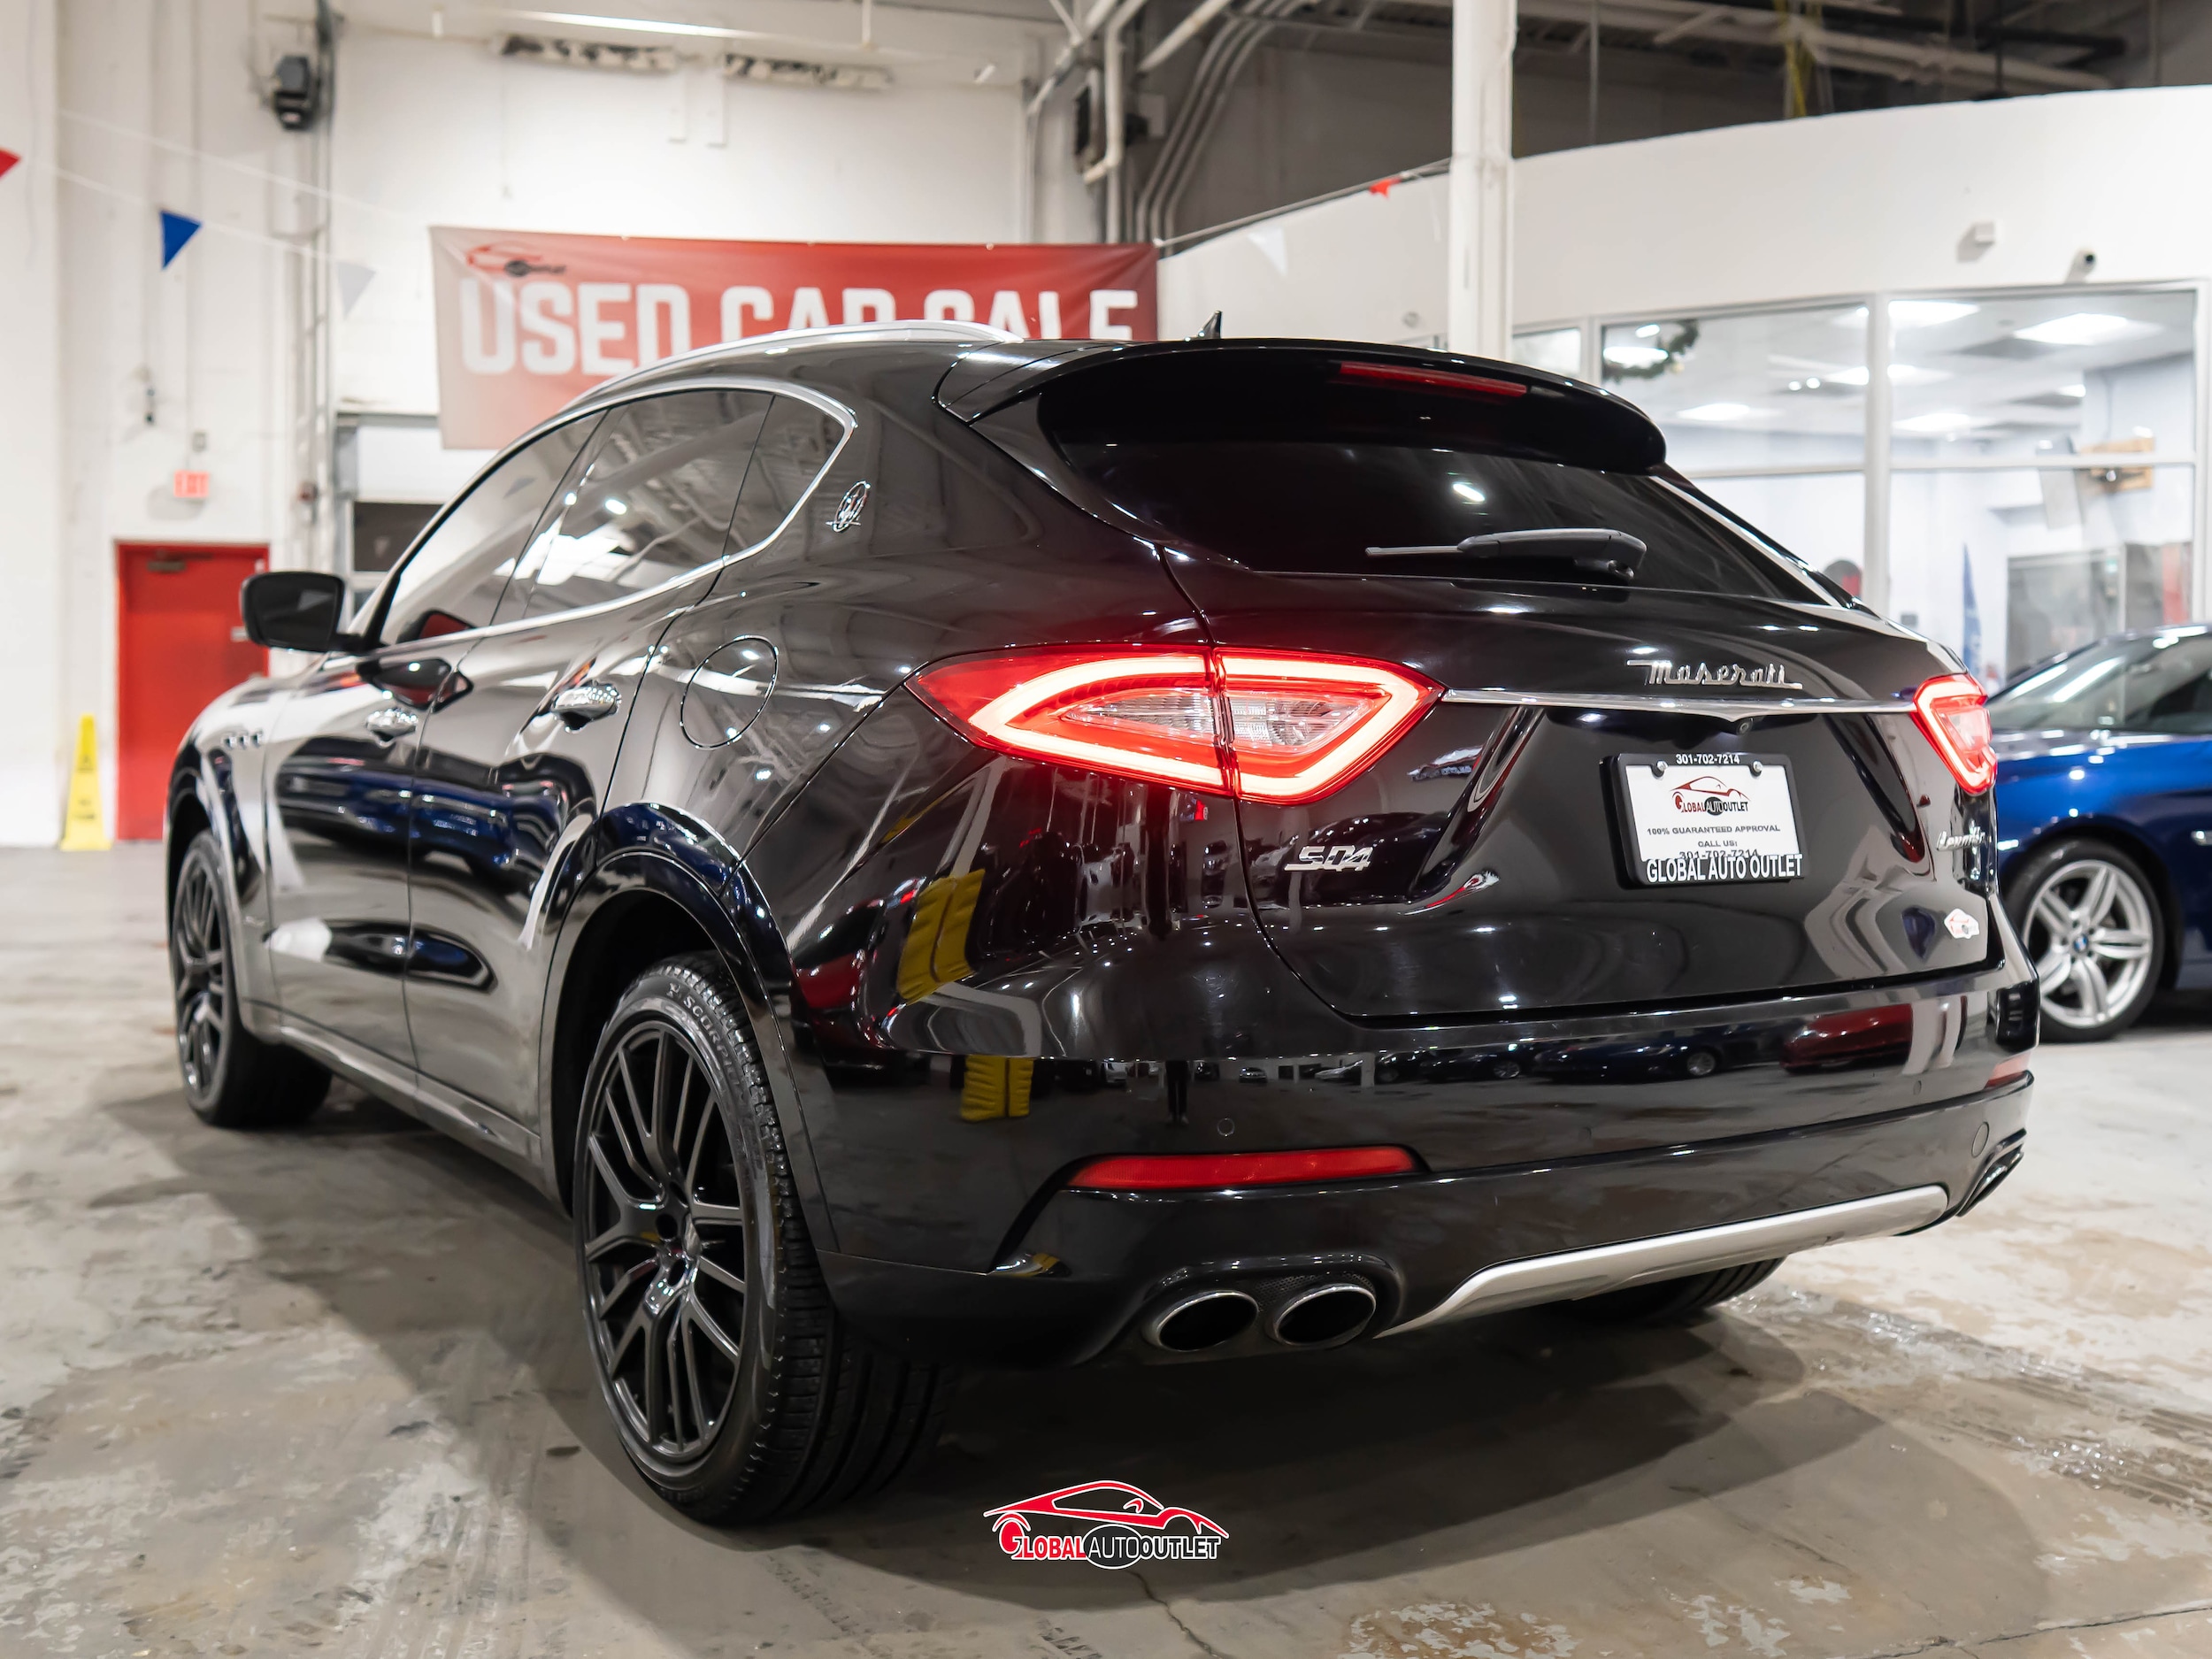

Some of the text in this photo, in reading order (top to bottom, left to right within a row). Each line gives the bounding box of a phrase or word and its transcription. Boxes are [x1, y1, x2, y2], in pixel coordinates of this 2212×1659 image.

[459, 277, 691, 376] USED
[1627, 659, 1802, 689] Maserati
[1675, 753, 1740, 764] 301-702-7214
[1671, 826, 1732, 834] GUARANTEED
[1646, 853, 1803, 883] GLOBAL AUTO OUTLET
